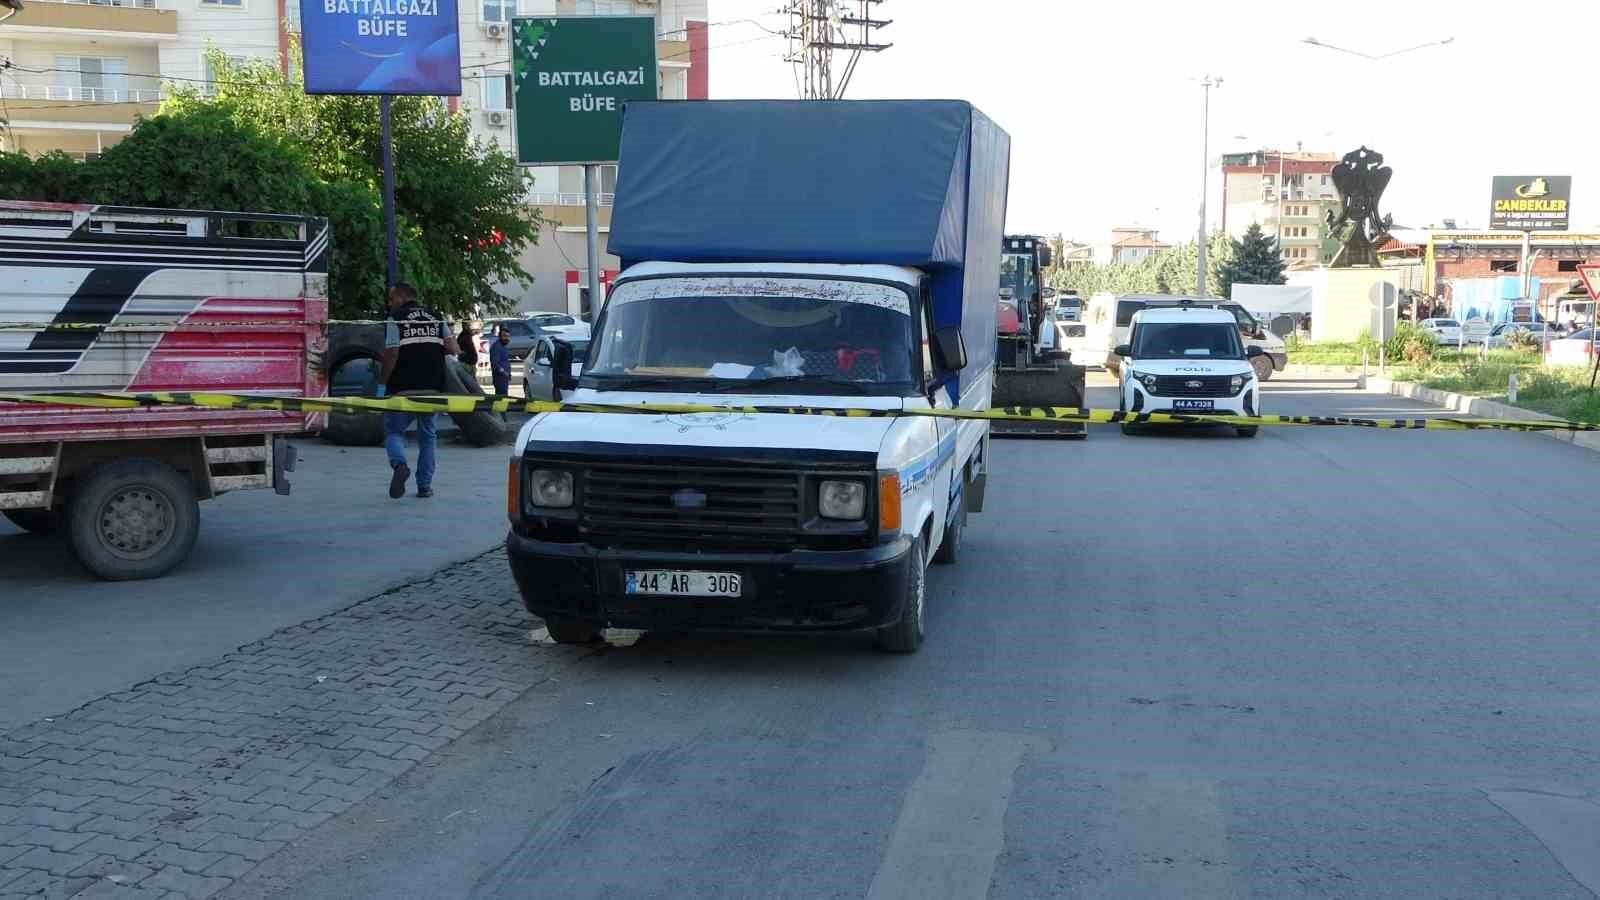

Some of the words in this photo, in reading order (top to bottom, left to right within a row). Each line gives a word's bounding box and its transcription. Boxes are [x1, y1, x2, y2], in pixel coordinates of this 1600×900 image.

[357, 16, 407, 37] BÜFE
[538, 66, 644, 86] BATTALGAZİ
[569, 93, 615, 112] BÜFE
[1495, 200, 1565, 210] CANBEKLER
[640, 573, 659, 592] 44
[670, 574, 689, 593] AR
[707, 575, 739, 593] 306
